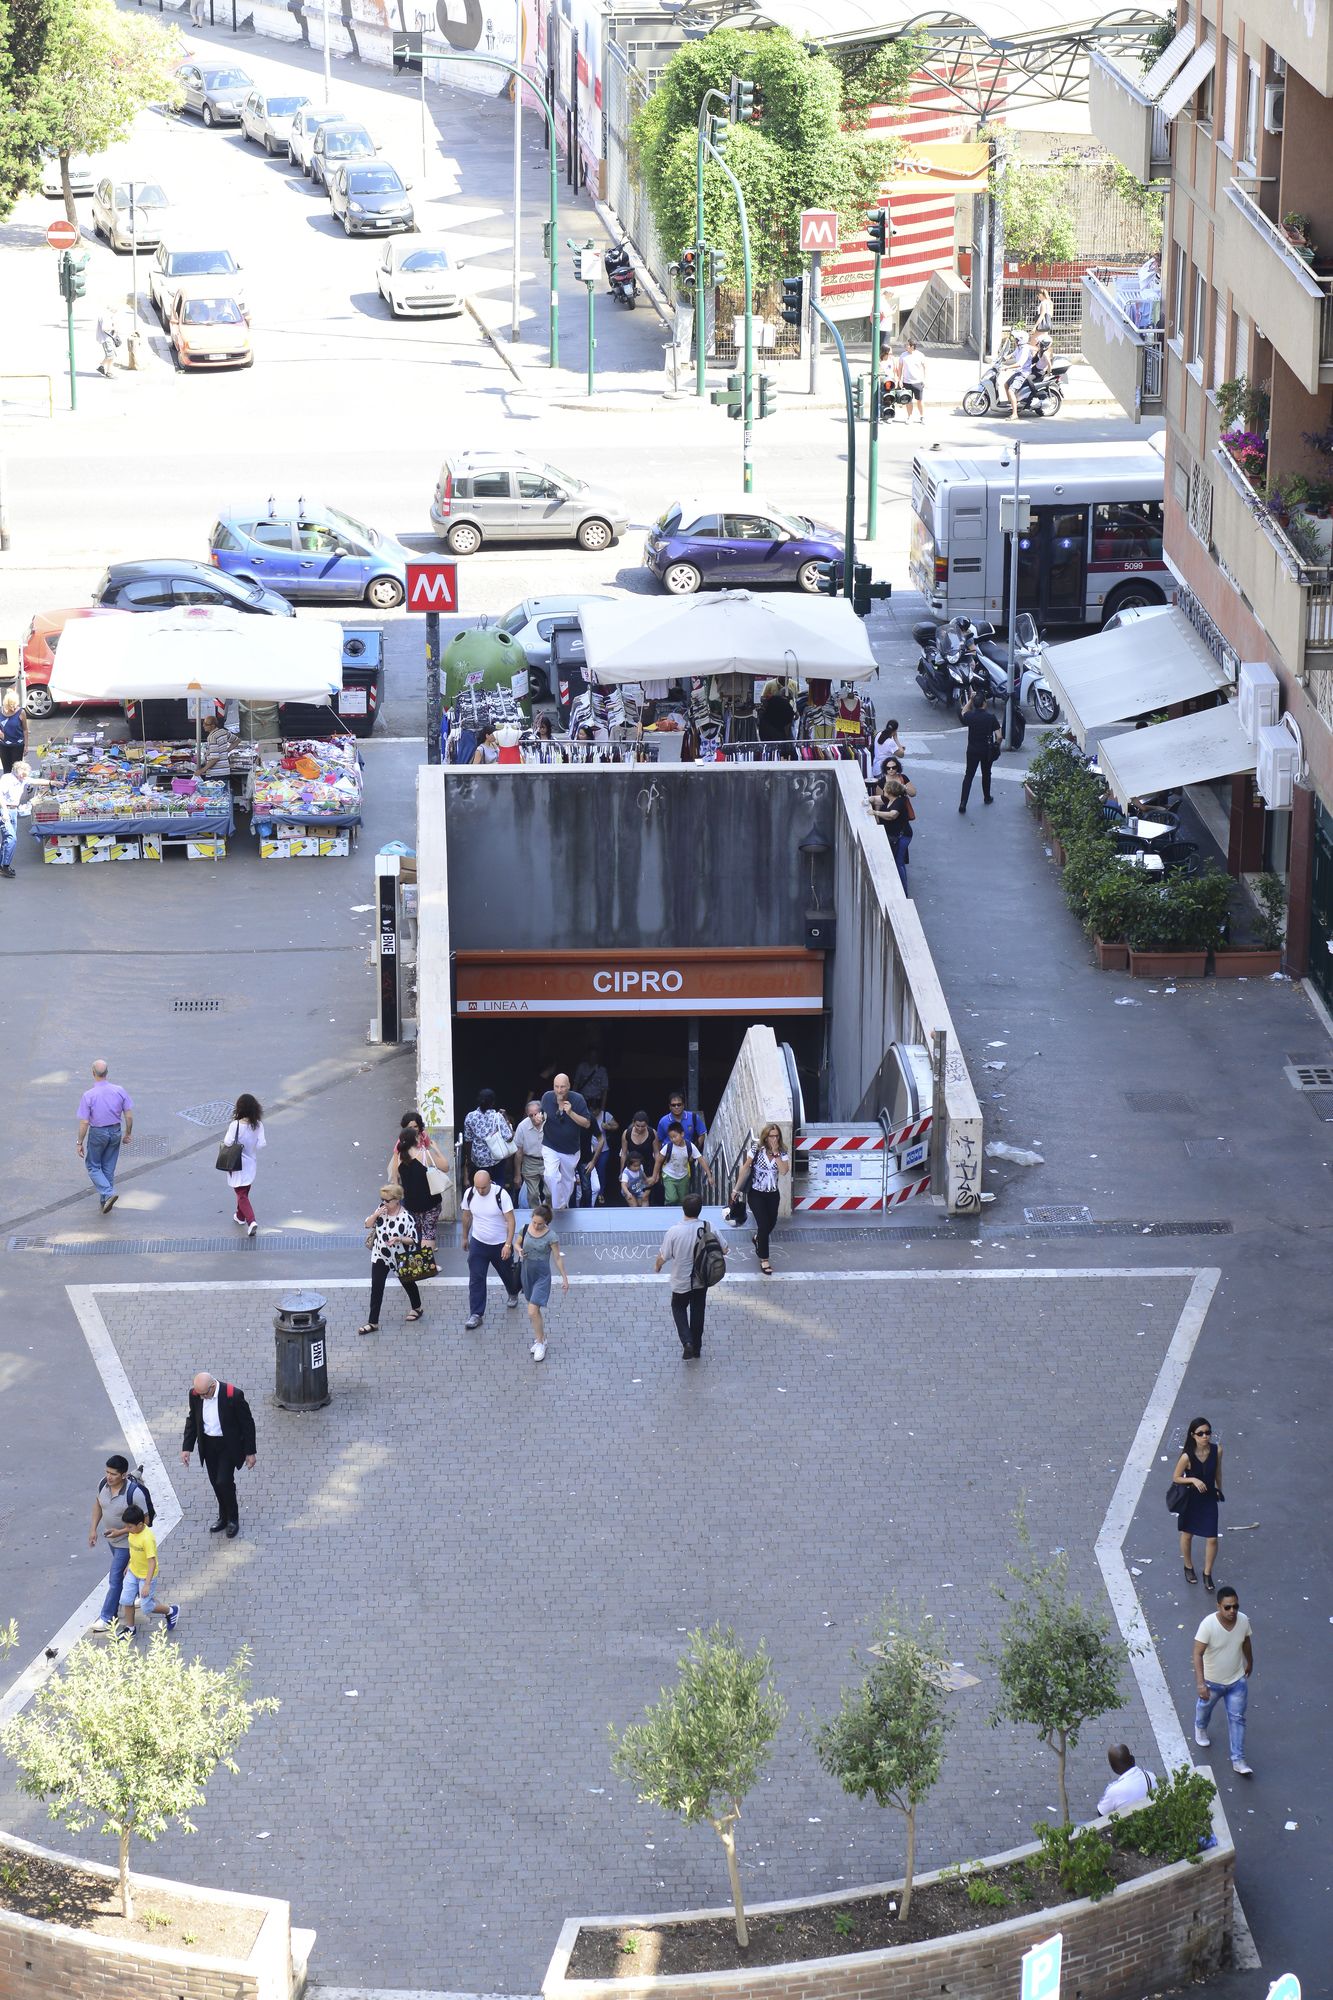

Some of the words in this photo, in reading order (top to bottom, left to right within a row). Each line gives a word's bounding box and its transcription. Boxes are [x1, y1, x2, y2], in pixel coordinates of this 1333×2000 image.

[890, 157, 932, 174] PRO
[803, 221, 834, 243] M
[1124, 562, 1144, 570] 5099
[411, 573, 452, 602] M
[382, 935, 394, 953] BNE
[593, 970, 683, 993] CIPRO
[483, 1001, 517, 1011] LINEA
[520, 1001, 529, 1010] A
[906, 1147, 923, 1165] KONE
[826, 1164, 852, 1176] KONE
[313, 1342, 323, 1367] BNE
[1030, 1961, 1053, 1996] P
